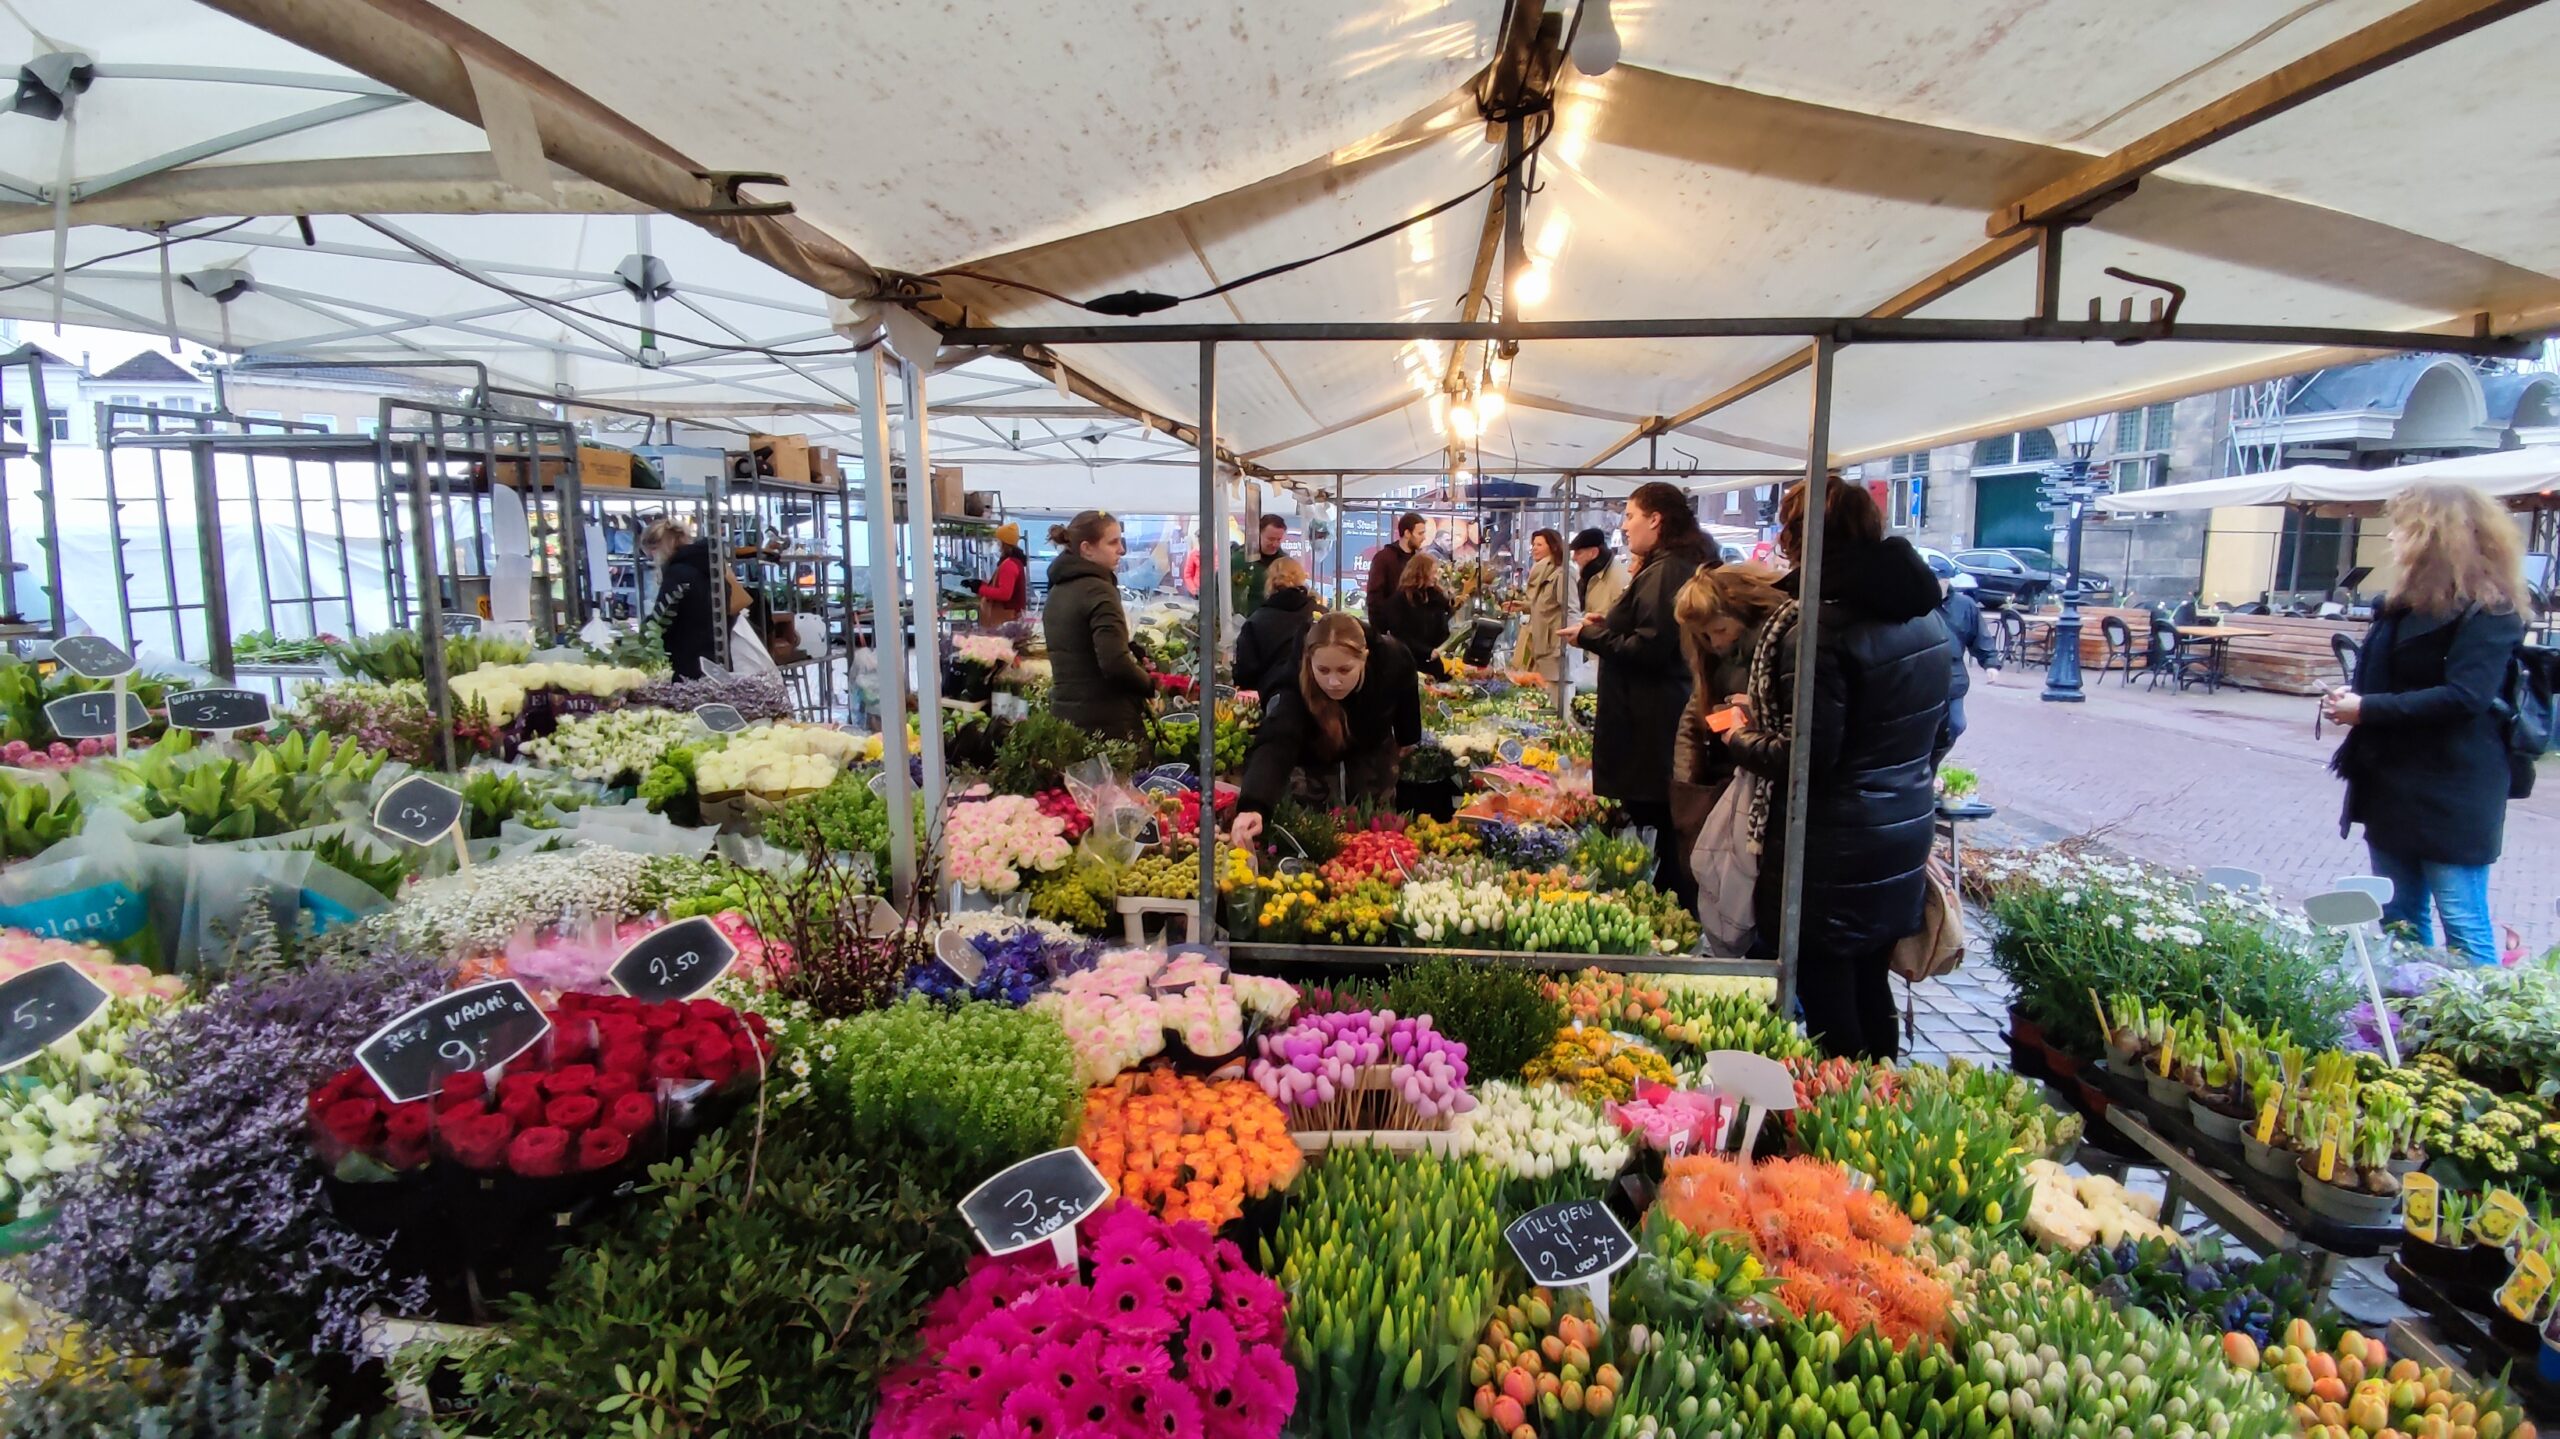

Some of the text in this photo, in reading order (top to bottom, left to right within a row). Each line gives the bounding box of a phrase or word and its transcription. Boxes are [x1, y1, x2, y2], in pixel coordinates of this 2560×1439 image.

[649, 951, 700, 986] 2.50
[1516, 1203, 1594, 1241] TULPEN
[1539, 1250, 1567, 1280] 2
